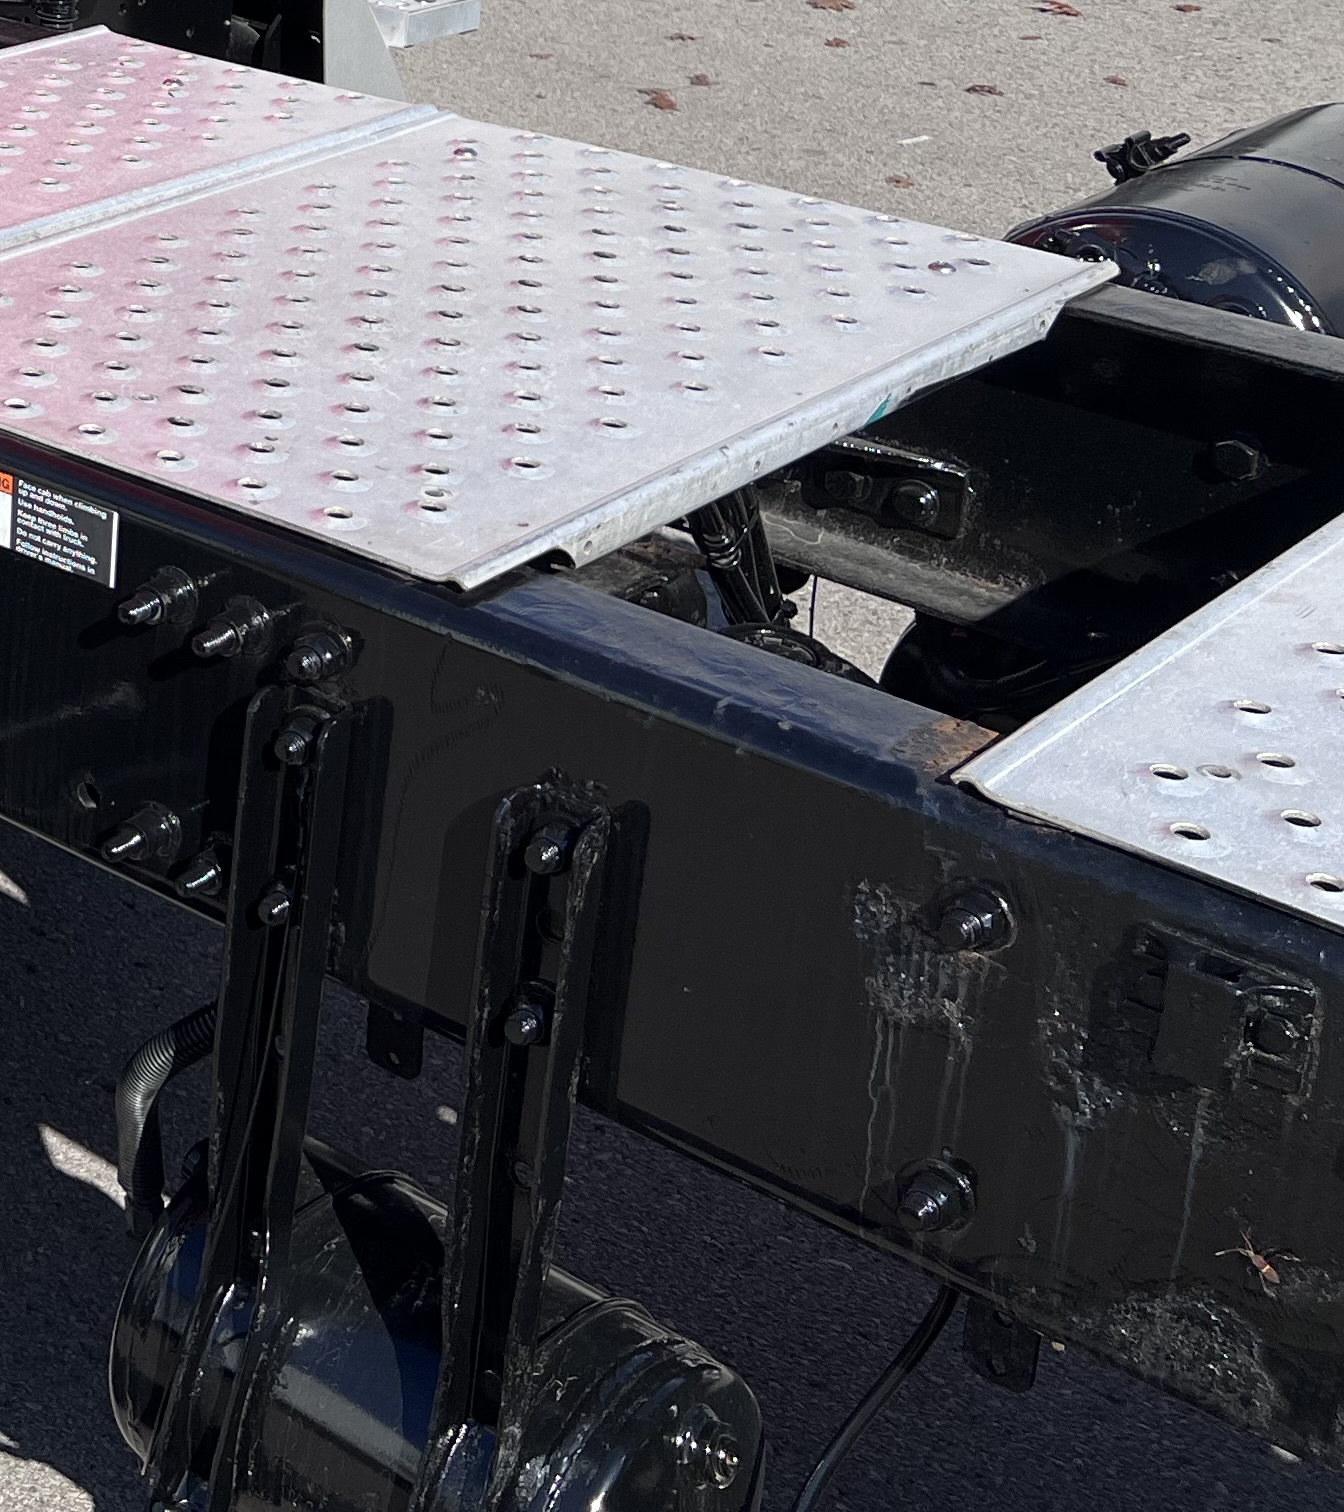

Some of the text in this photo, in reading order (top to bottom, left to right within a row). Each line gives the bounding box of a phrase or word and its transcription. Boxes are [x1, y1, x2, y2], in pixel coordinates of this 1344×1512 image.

[18, 488, 68, 511] up and down.
[18, 480, 107, 520] Face cab when climbing
[18, 498, 75, 525] Use handholds.
[17, 518, 85, 548] contact with truck.
[18, 510, 88, 541] Keep three limbs in
[16, 538, 96, 574] Follow instructions in
[17, 527, 97, 565] Do not carry anything.
